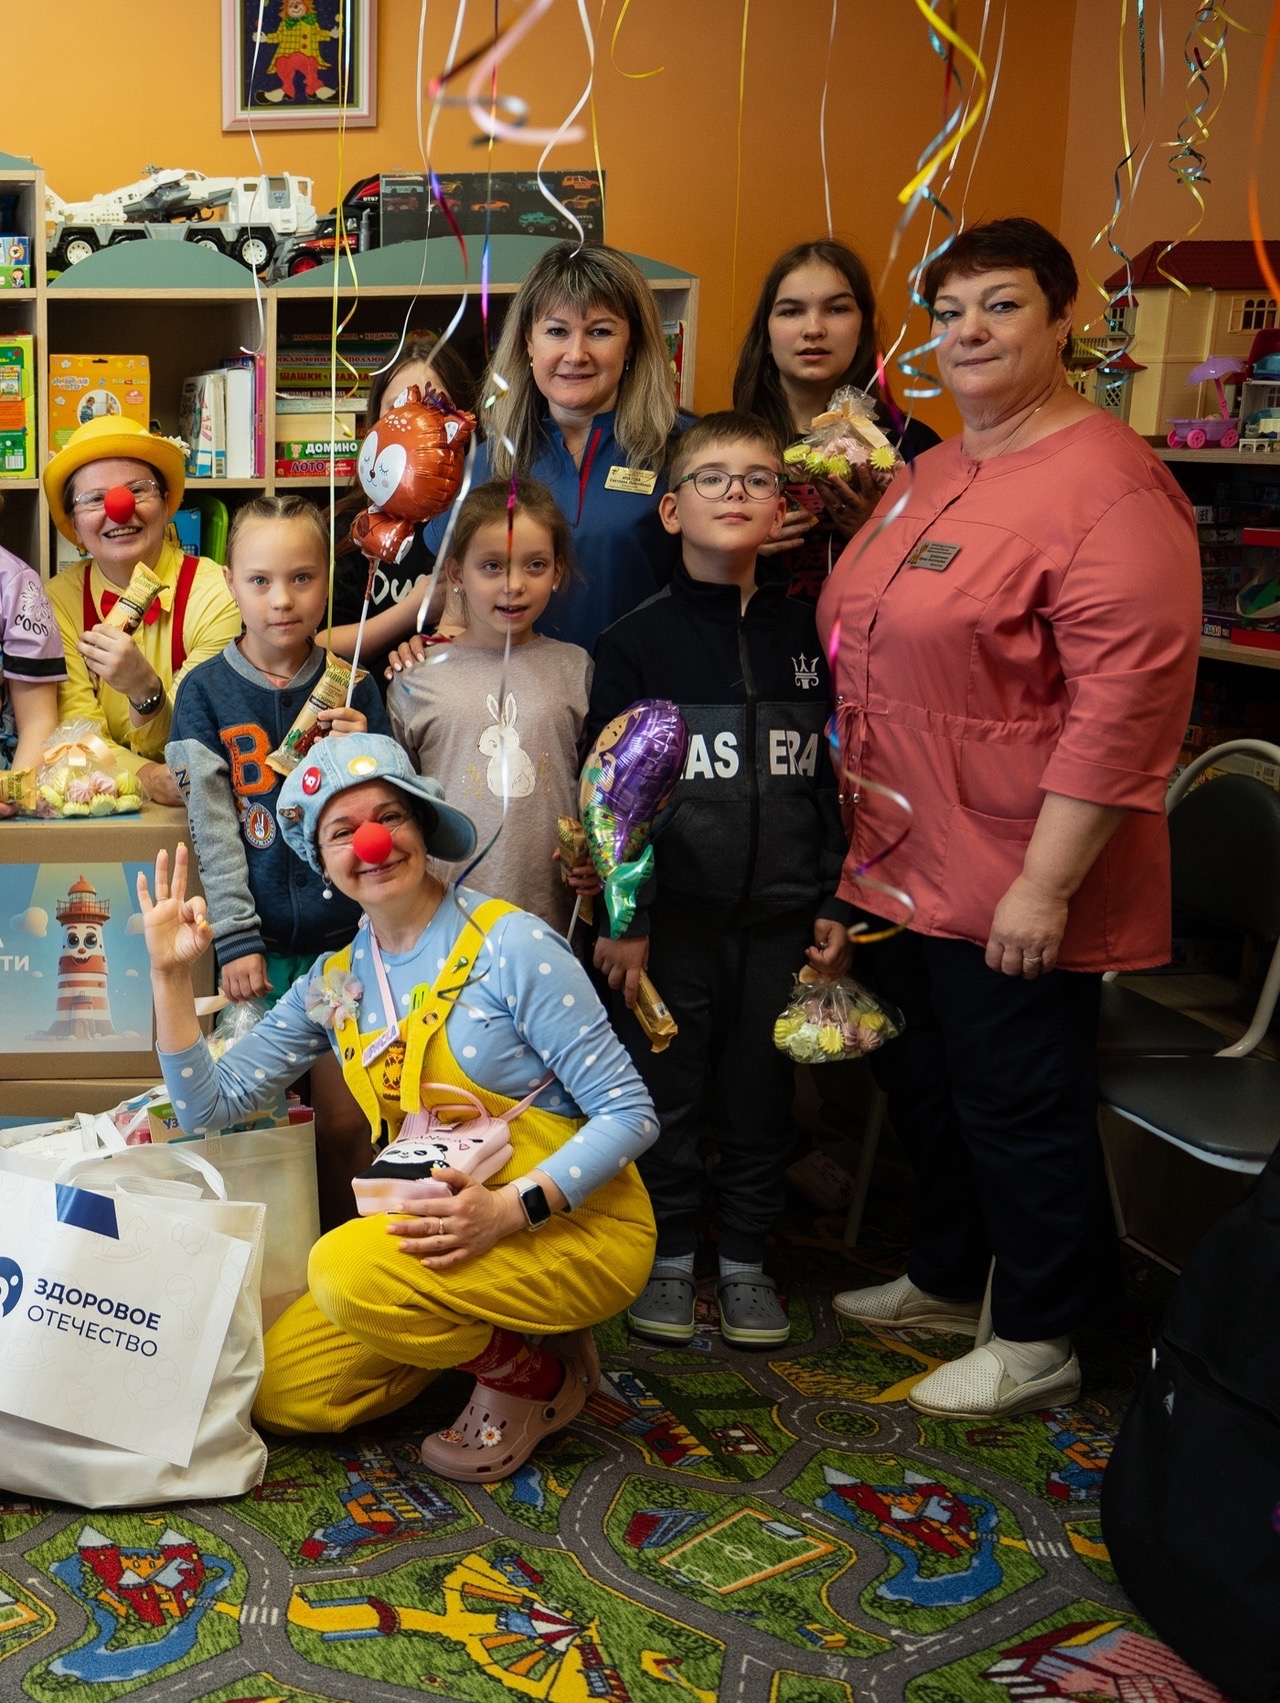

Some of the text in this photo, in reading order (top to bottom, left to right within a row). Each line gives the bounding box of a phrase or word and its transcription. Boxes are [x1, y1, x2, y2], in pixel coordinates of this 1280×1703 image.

[364, 332, 399, 340] ХОДИЛКА
[280, 372, 322, 381] ШАШКИ
[305, 442, 359, 454] ДОМИНО
[290, 461, 325, 472] ЛОТО
[218, 723, 278, 796] B
[680, 729, 819, 780] AS ERA
[33, 1277, 162, 1332] ЗДОРОВОЕ
[26, 1304, 159, 1358] ОТЕЧЕСТВО
